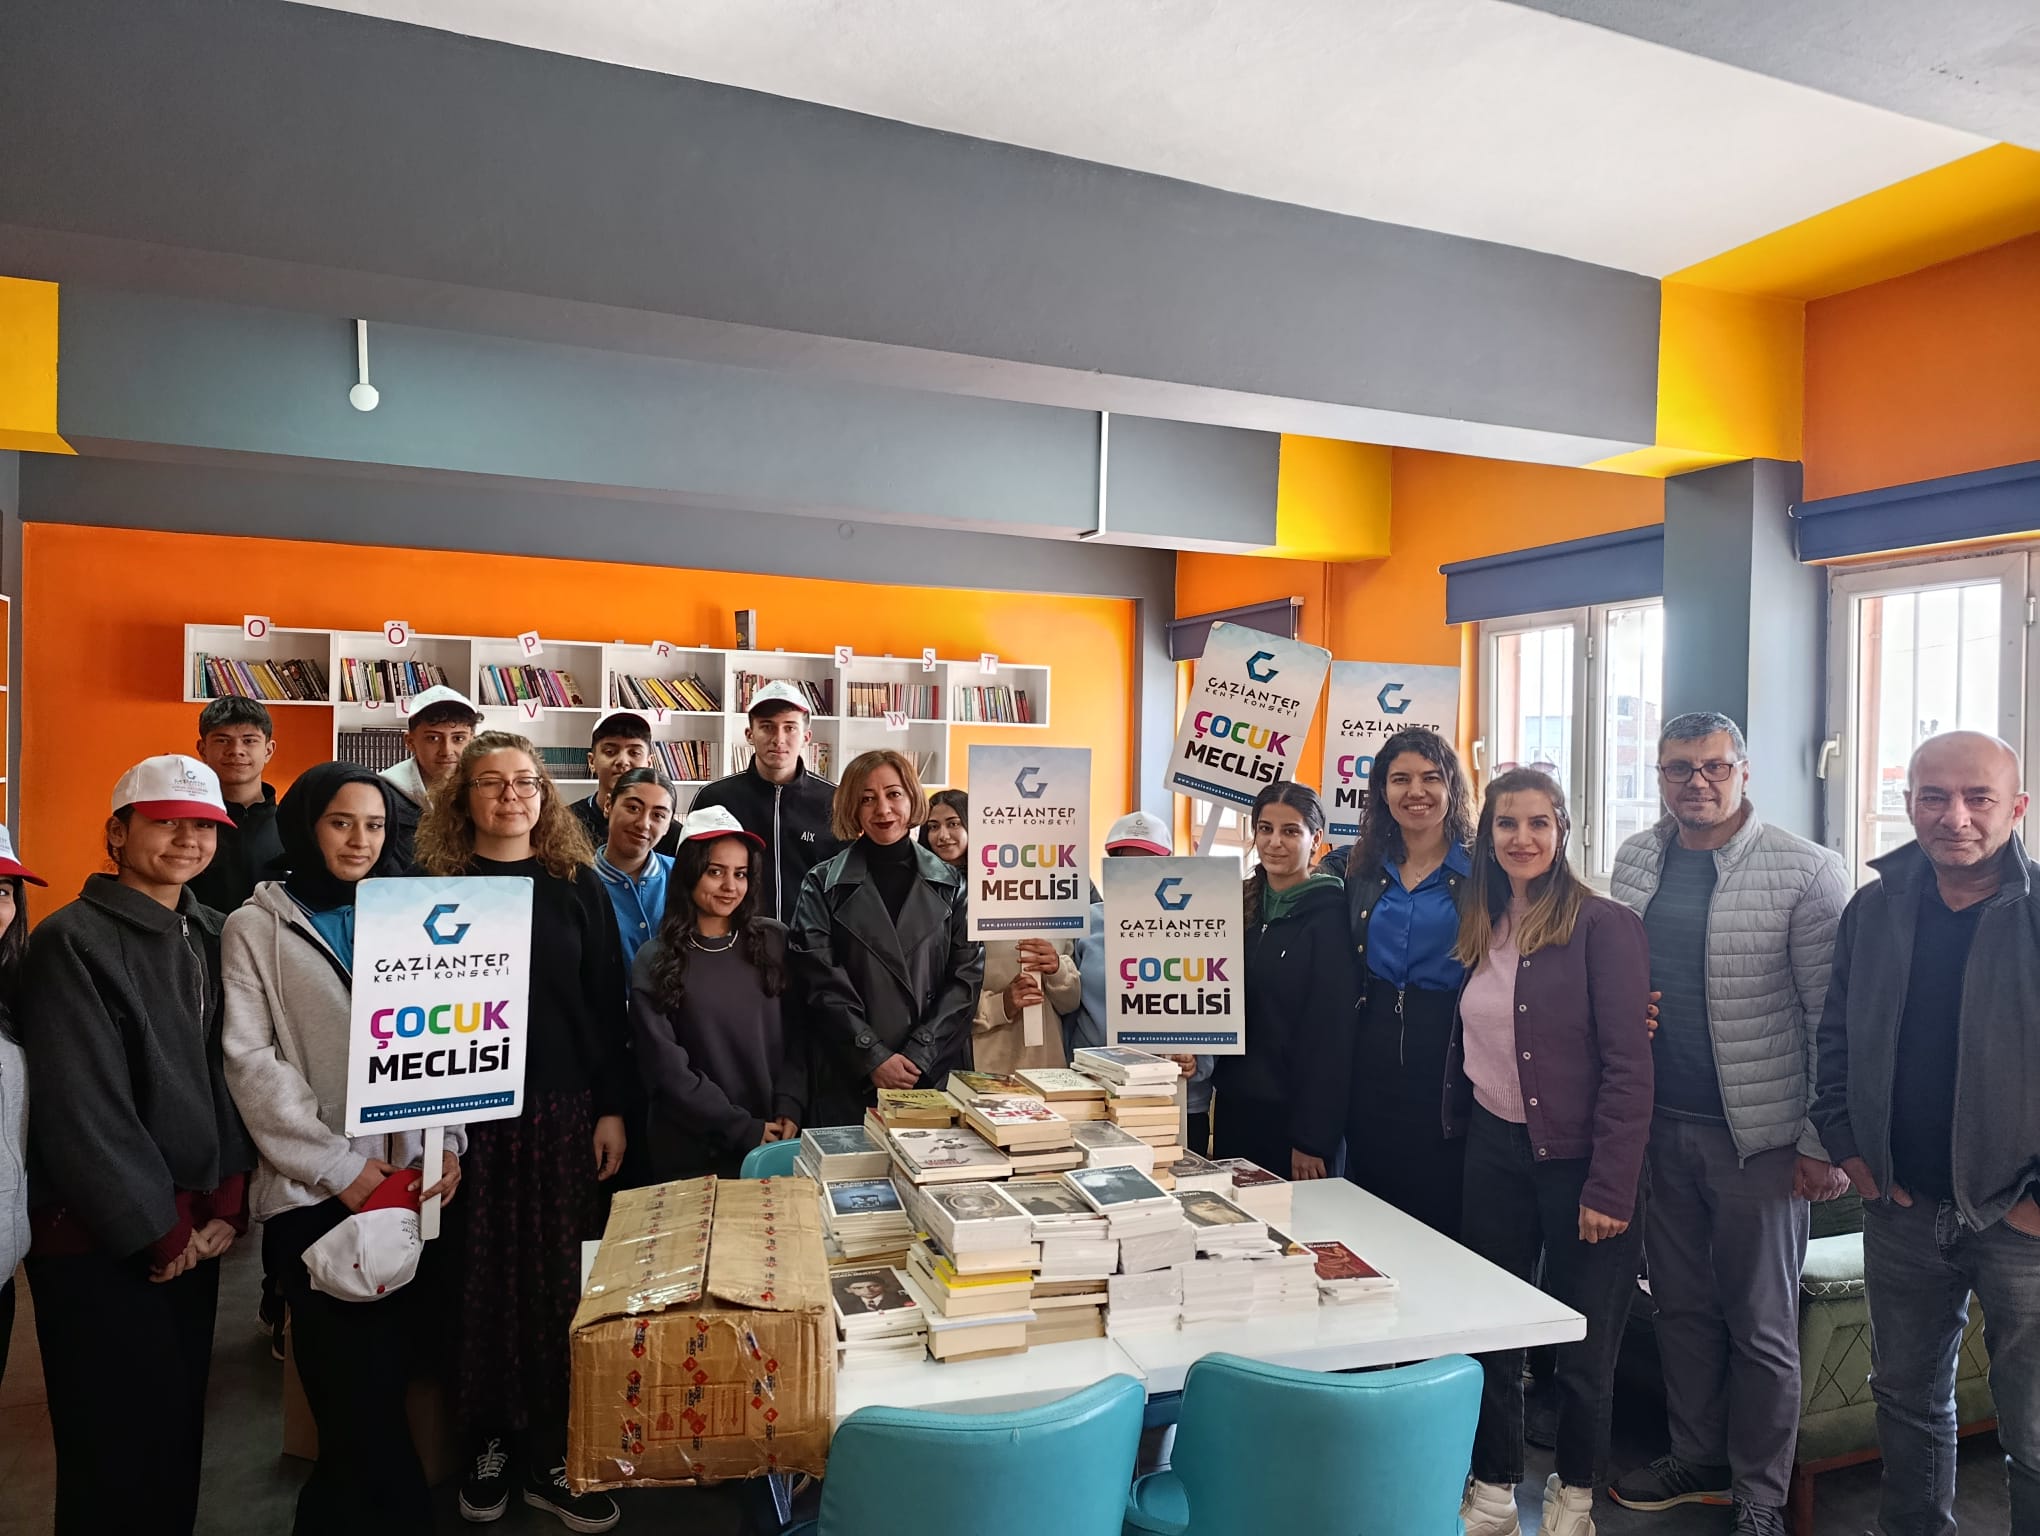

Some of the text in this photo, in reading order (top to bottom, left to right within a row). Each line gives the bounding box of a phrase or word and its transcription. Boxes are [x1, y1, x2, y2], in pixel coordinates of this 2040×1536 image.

[247, 619, 266, 638] O
[388, 623, 405, 645] Ö
[524, 636, 536, 654] P
[656, 644, 670, 658] R
[839, 648, 849, 664] S
[924, 650, 933, 670] Ş
[984, 656, 995, 671] T
[1205, 687, 1297, 718] KENT KONSEYİ
[1208, 677, 1301, 710] GAZİANTEP
[524, 702, 538, 718] V
[655, 708, 666, 722] Y
[887, 713, 906, 727] W
[1194, 710, 1291, 757] ÇOCUK
[1184, 740, 1285, 784] MECLİSİ
[983, 804, 1076, 818] GAZİANTEP
[981, 843, 1077, 876] ÇOCUK
[981, 873, 1078, 902] MECLİSİ
[1120, 916, 1227, 931] GAZİANTEP
[1120, 930, 1227, 938] KENT KONSEYİ
[374, 953, 511, 973] GAZİANTEP
[373, 966, 511, 983] KENT KONSEYİ
[1119, 957, 1230, 990] ÇOCUK
[1121, 988, 1231, 1015] MECLİSİ
[370, 1000, 510, 1049] ÇOCUK
[368, 1037, 510, 1084] MECLİSİ
